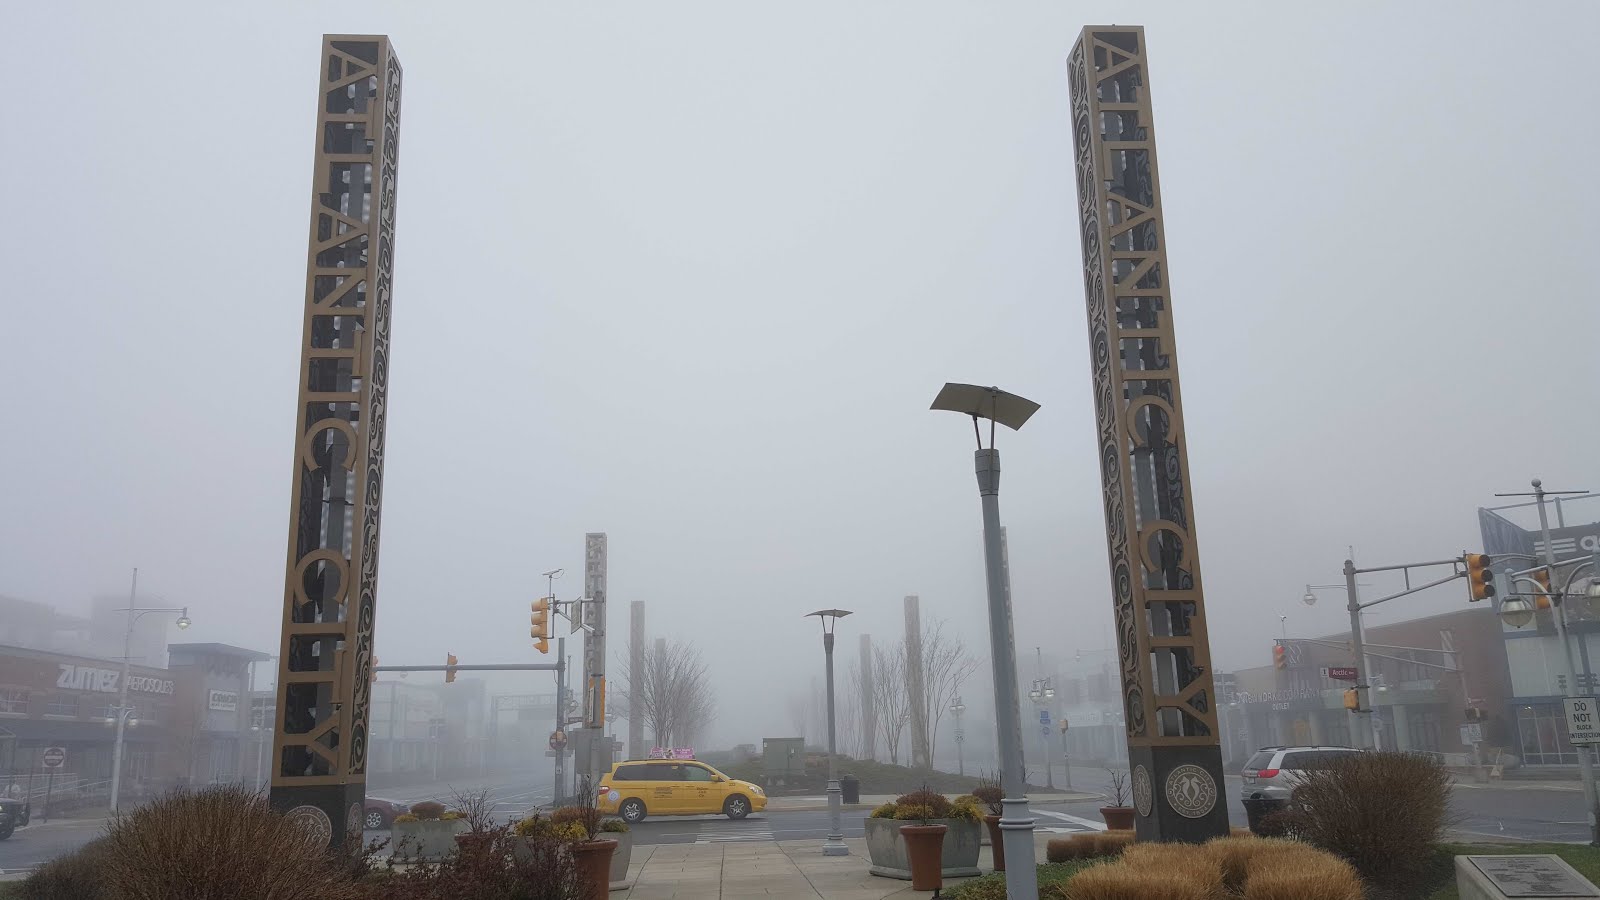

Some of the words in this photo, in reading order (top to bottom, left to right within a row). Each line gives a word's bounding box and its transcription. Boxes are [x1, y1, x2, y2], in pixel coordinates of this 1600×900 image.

[304, 45, 378, 472] ATLANTIC
[1092, 32, 1177, 446] ATLANTIC
[1140, 520, 1212, 735] CITY
[281, 548, 350, 770] CITY
[1332, 668, 1348, 676] Arctic
[1573, 702, 1587, 711] DO
[1573, 713, 1591, 722] NOT
[1168, 767, 1197, 786] ATLANTIC
[1199, 770, 1213, 786] CITY
